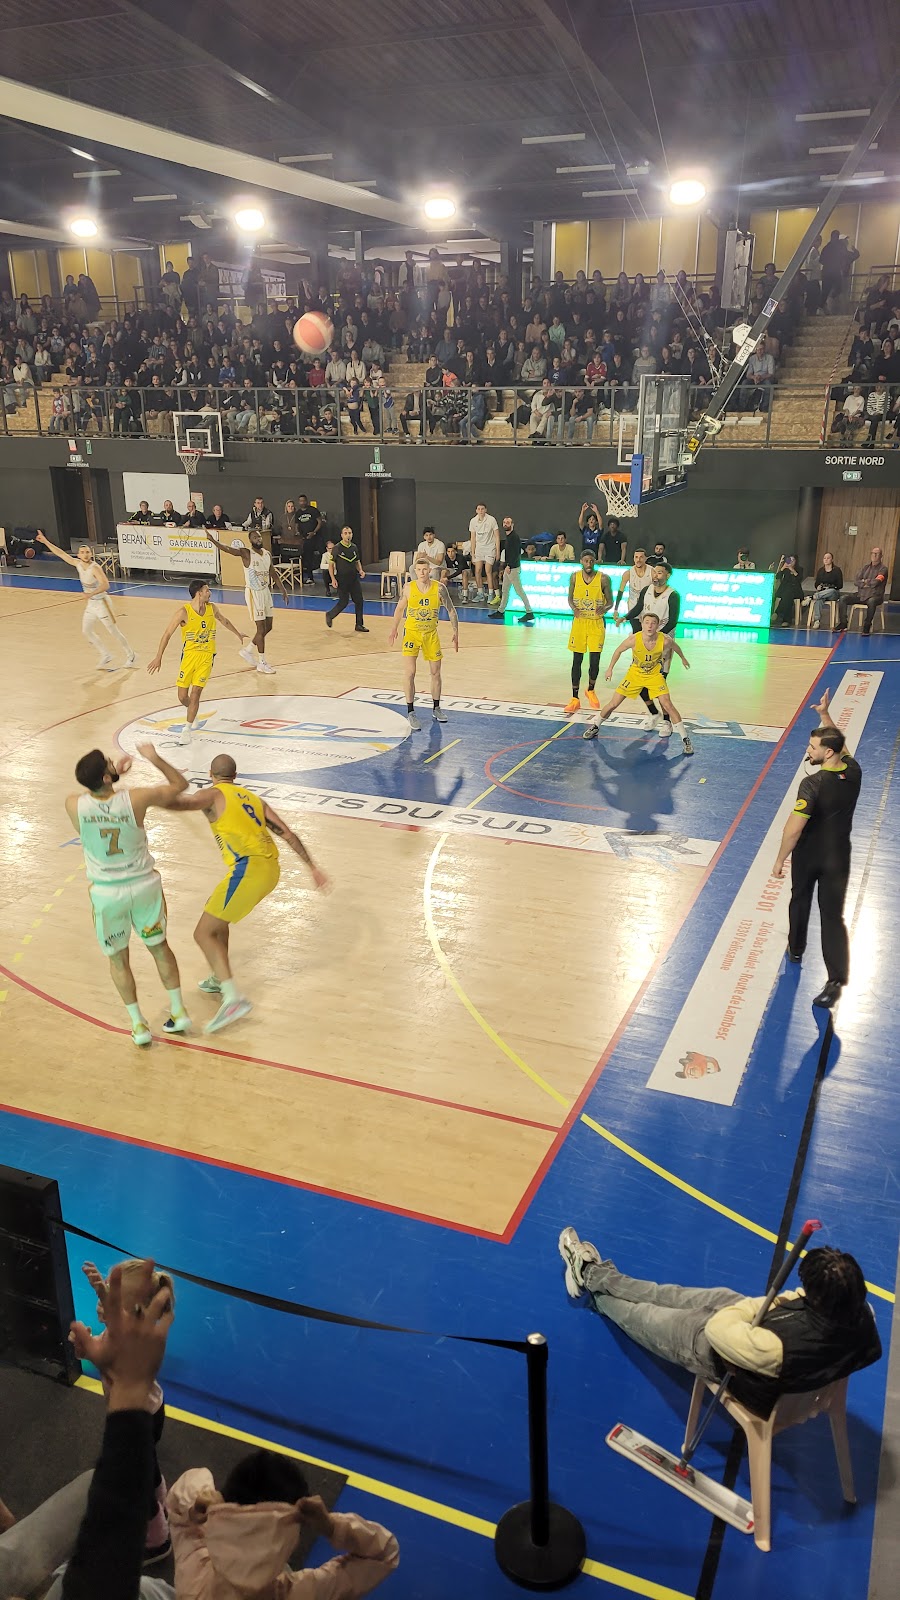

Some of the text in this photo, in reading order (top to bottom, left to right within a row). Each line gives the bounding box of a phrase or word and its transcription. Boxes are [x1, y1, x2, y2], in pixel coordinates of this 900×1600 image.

[825, 456, 885, 466] SORTIE NORD
[169, 539, 213, 549] GAGNERAUD
[418, 598, 430, 606] 49
[201, 620, 206, 629] 6
[404, 641, 414, 649] 49
[645, 654, 652, 662] 11
[621, 679, 631, 689] 11
[240, 718, 383, 739] GPC
[188, 777, 368, 810] RFLETS
[372, 802, 443, 820] DU
[449, 813, 552, 836] SUD
[99, 828, 124, 857] 7
[766, 878, 785, 889] 56
[760, 889, 780, 901] 39
[756, 901, 776, 912] 01
[736, 919, 753, 938] 13330
[759, 928, 771, 937] du
[753, 936, 768, 949] Bas
[734, 973, 754, 995] Route
[729, 994, 745, 1005] de
[715, 1004, 742, 1041] Lambesc
